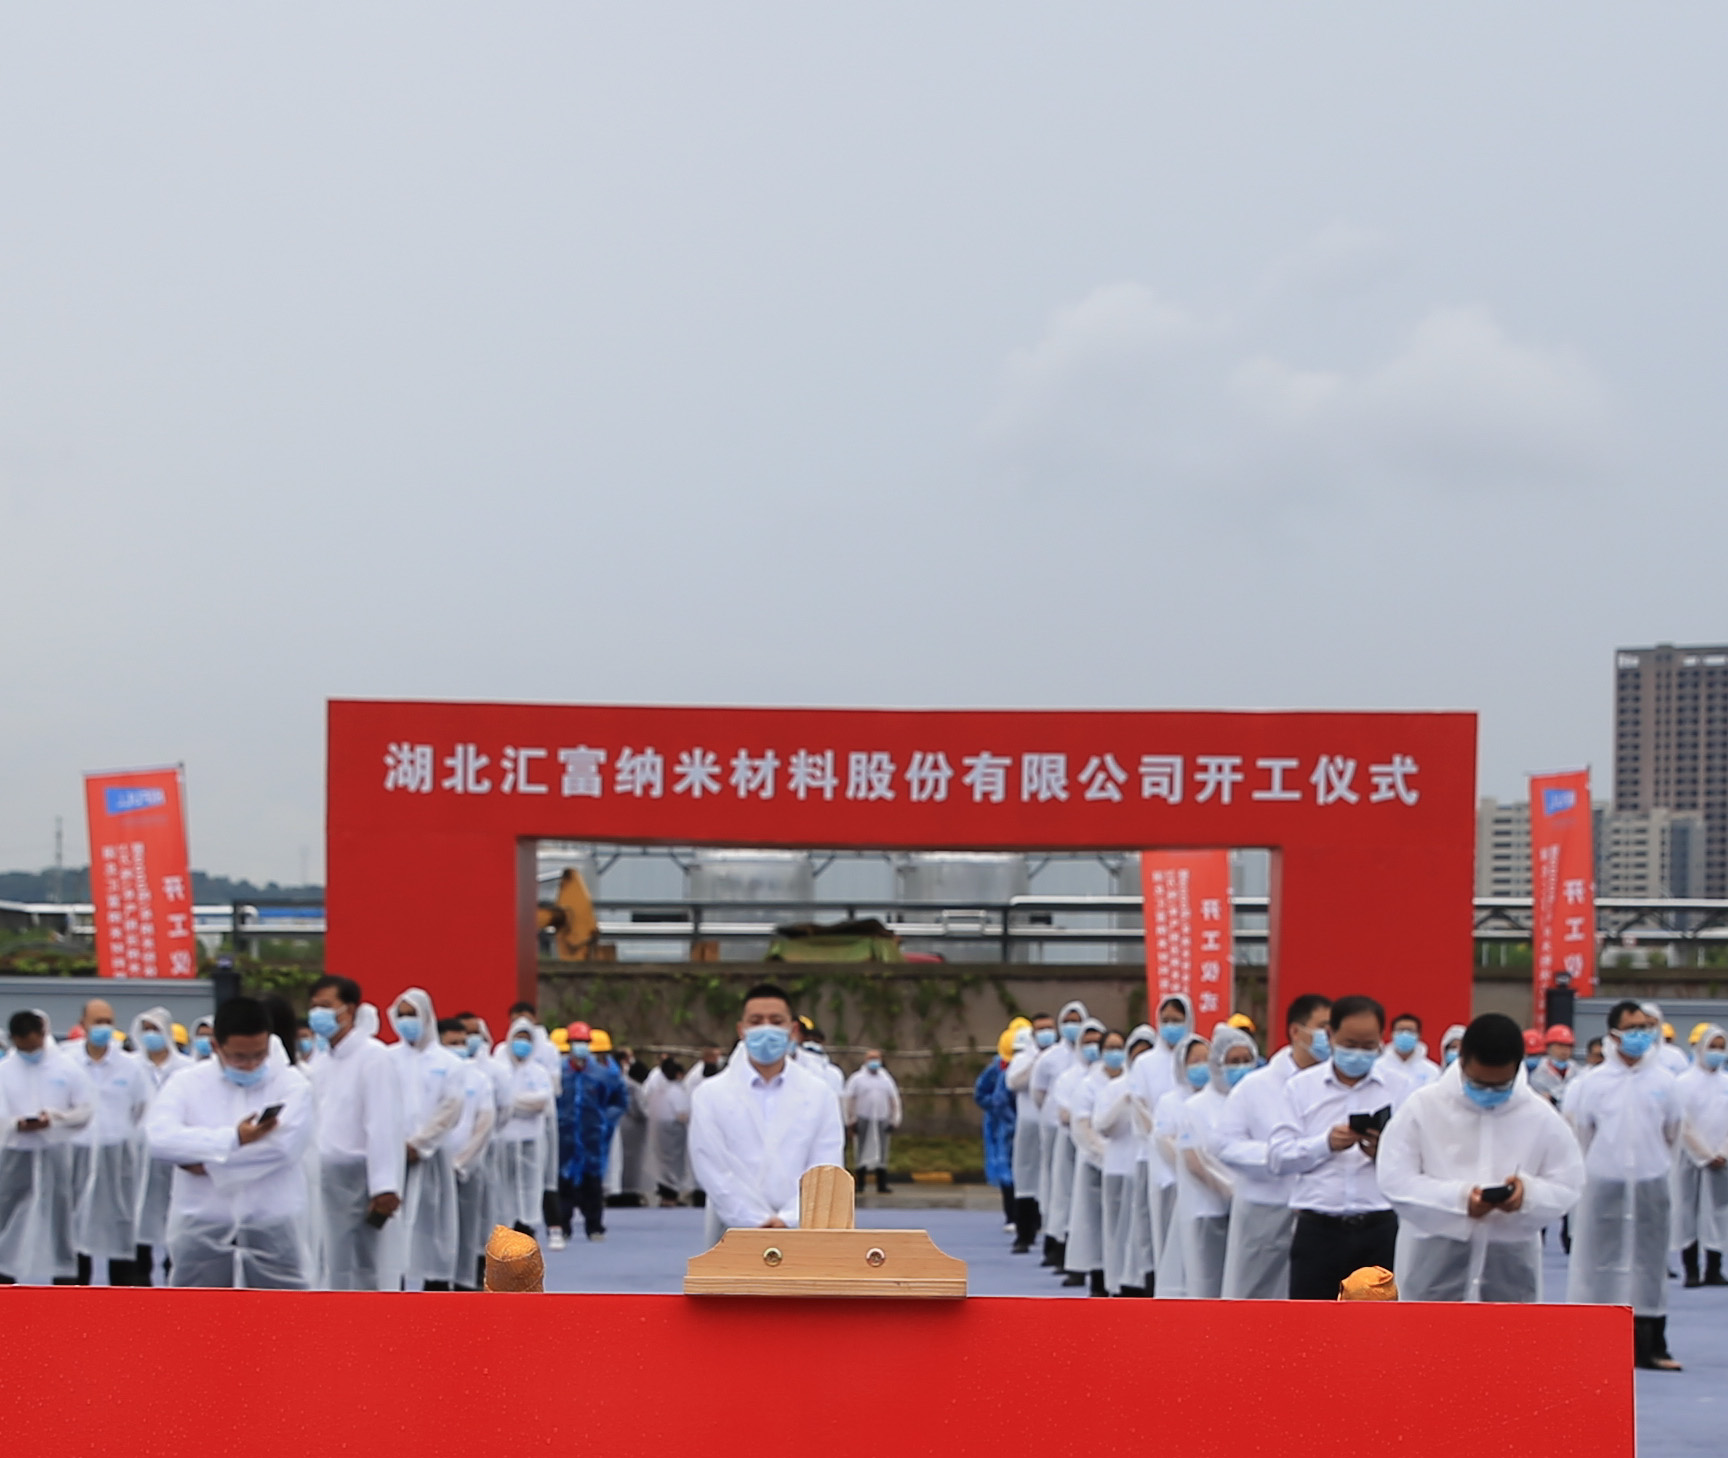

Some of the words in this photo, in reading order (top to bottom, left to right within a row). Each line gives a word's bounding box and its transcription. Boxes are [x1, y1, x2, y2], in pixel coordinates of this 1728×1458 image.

[384, 742, 1419, 806] 湖北汇富纳米材料股份有限公司开工仪式
